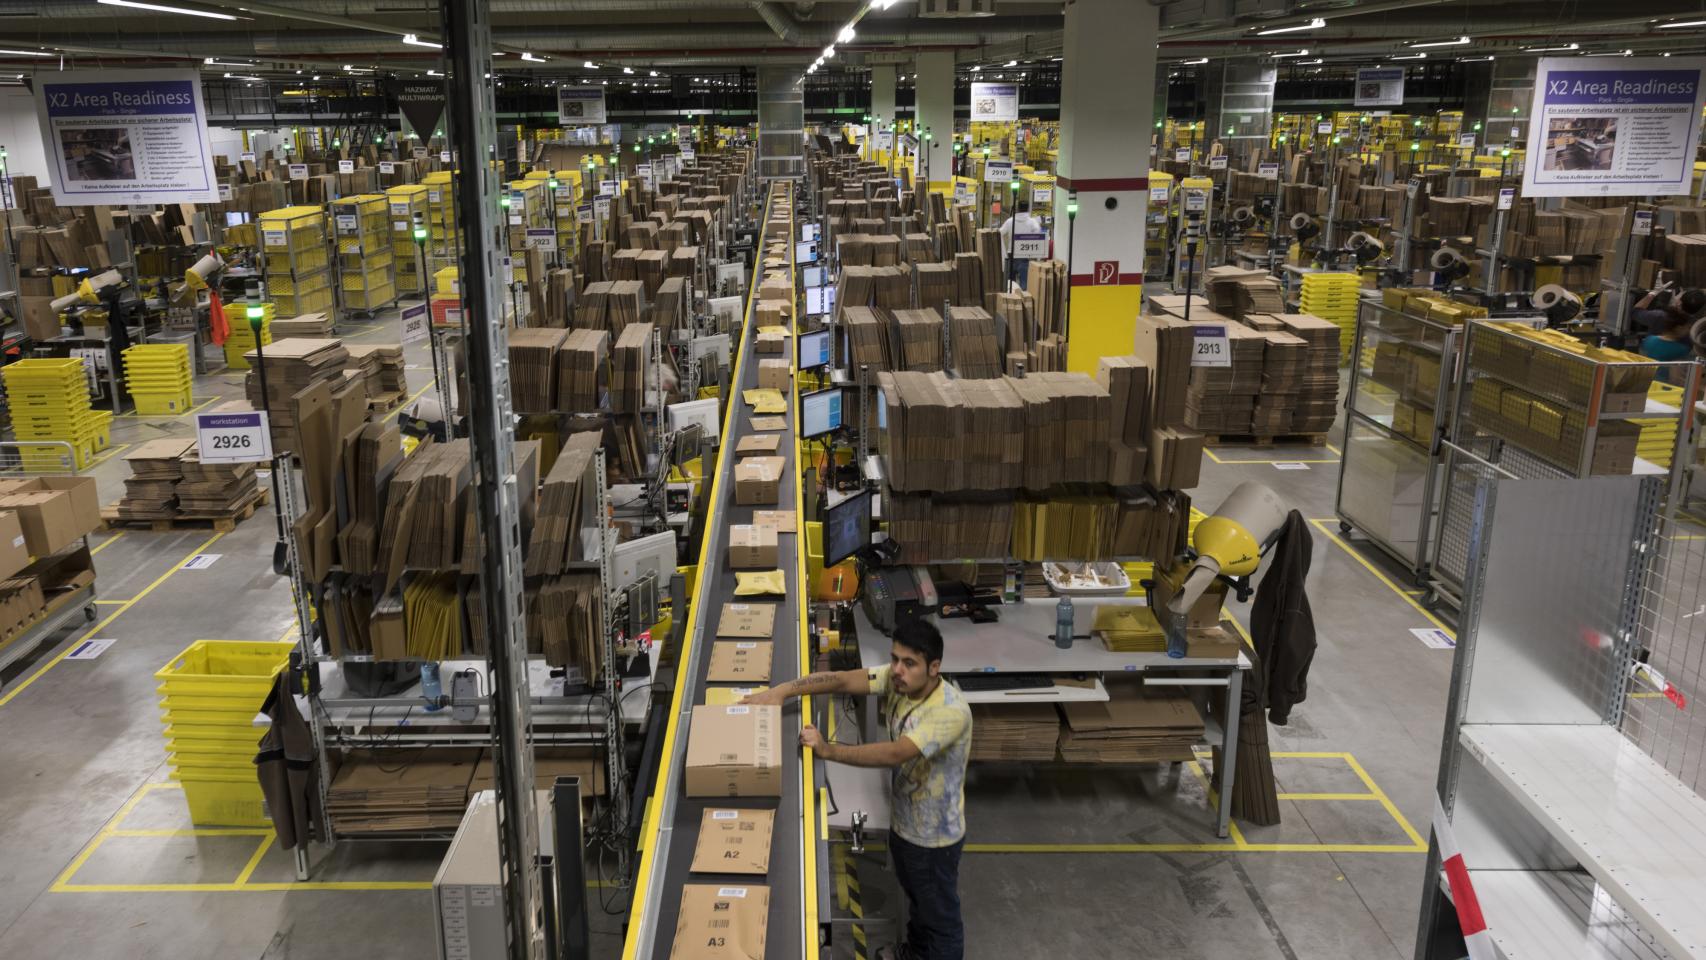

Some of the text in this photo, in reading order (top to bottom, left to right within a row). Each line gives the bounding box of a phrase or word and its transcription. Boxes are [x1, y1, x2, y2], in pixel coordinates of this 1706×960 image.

[1549, 80, 1694, 95] X2 Area Readiness
[49, 91, 191, 107] X2 Area Readiness
[1020, 243, 1039, 251] 2911
[1197, 343, 1221, 354] 2913
[213, 435, 251, 448] 2926
[723, 850, 740, 859] A2
[707, 937, 726, 947] A3
